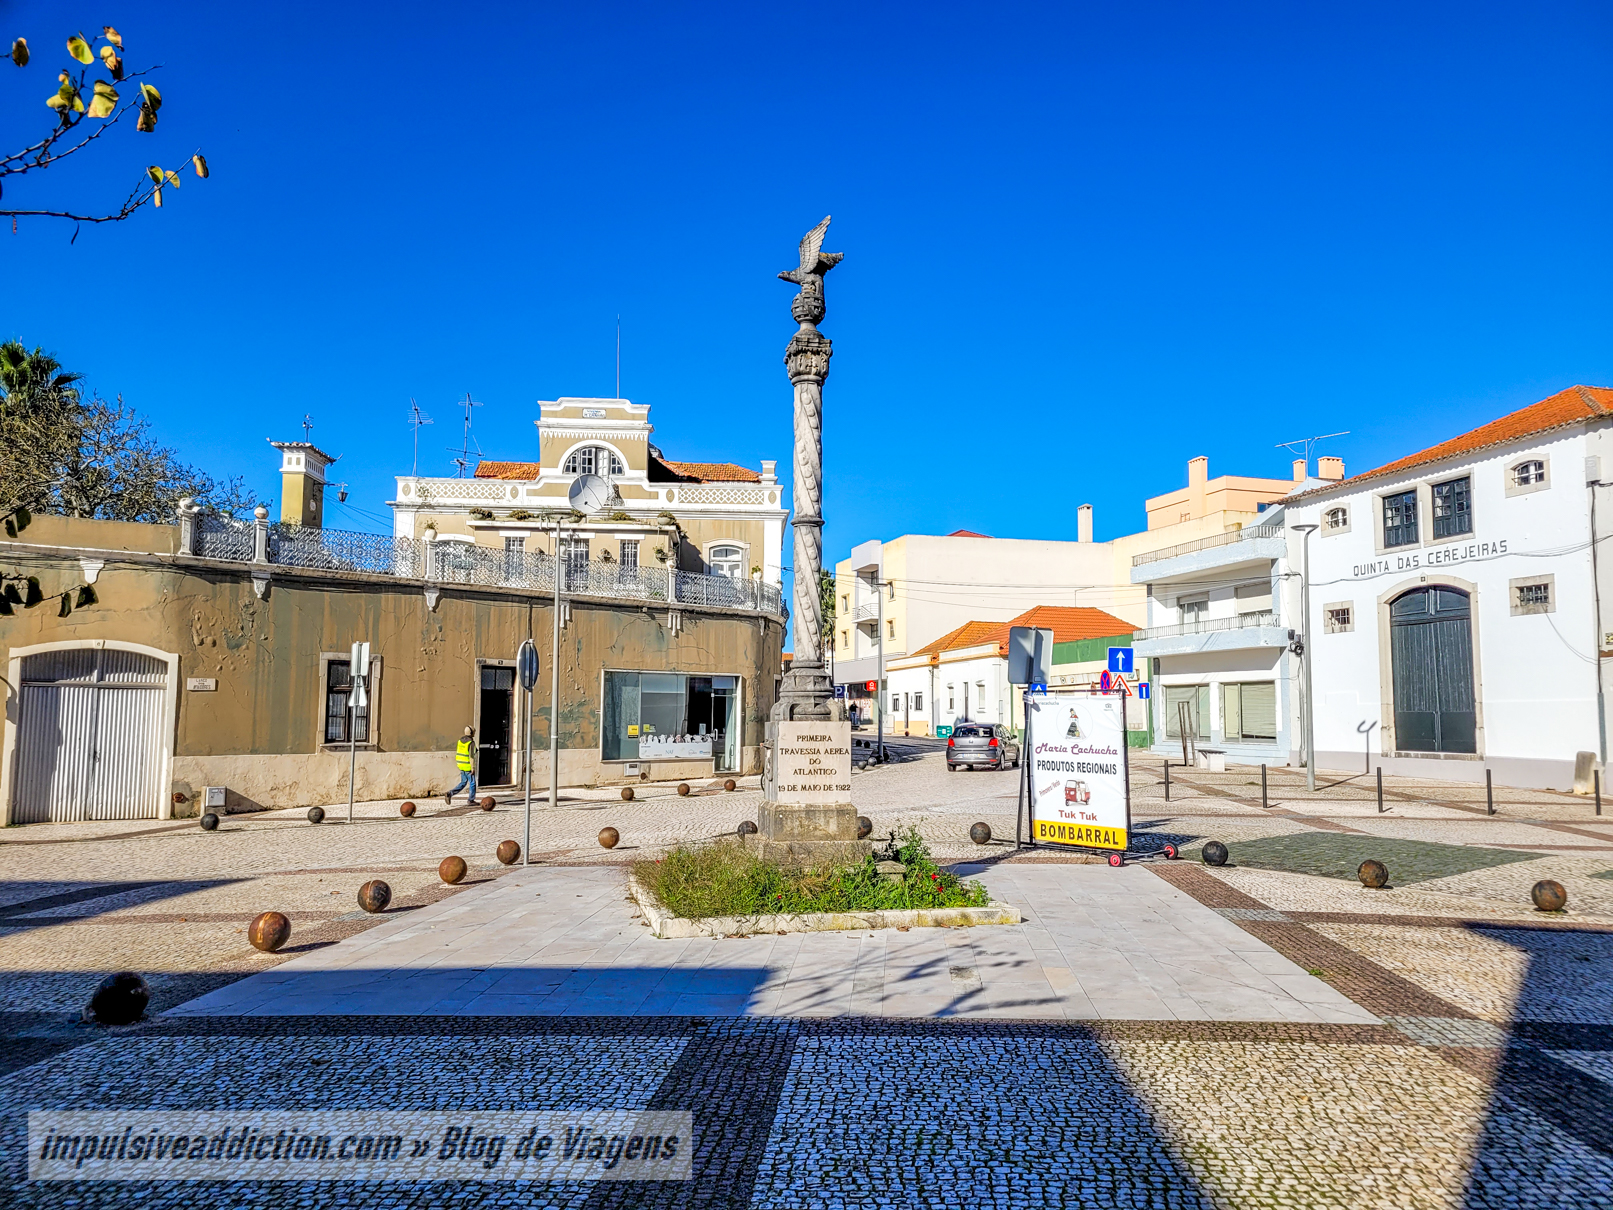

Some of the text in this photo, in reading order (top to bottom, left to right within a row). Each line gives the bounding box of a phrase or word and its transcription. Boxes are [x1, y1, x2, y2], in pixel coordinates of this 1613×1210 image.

[1352, 540, 1508, 577] QUINTA DAS CEREJEIRAS
[1035, 742, 1118, 756] Maria Cachucha
[792, 768, 837, 776] ATLANTICO
[1037, 759, 1117, 775] PRODUTOS REGIONAIS
[778, 784, 786, 792] 19
[787, 784, 799, 792] DE
[800, 784, 822, 792] MAIO
[823, 784, 834, 792] DE
[1058, 809, 1098, 821] Tuk Tuk
[1040, 823, 1119, 845] BOMBARRAL
